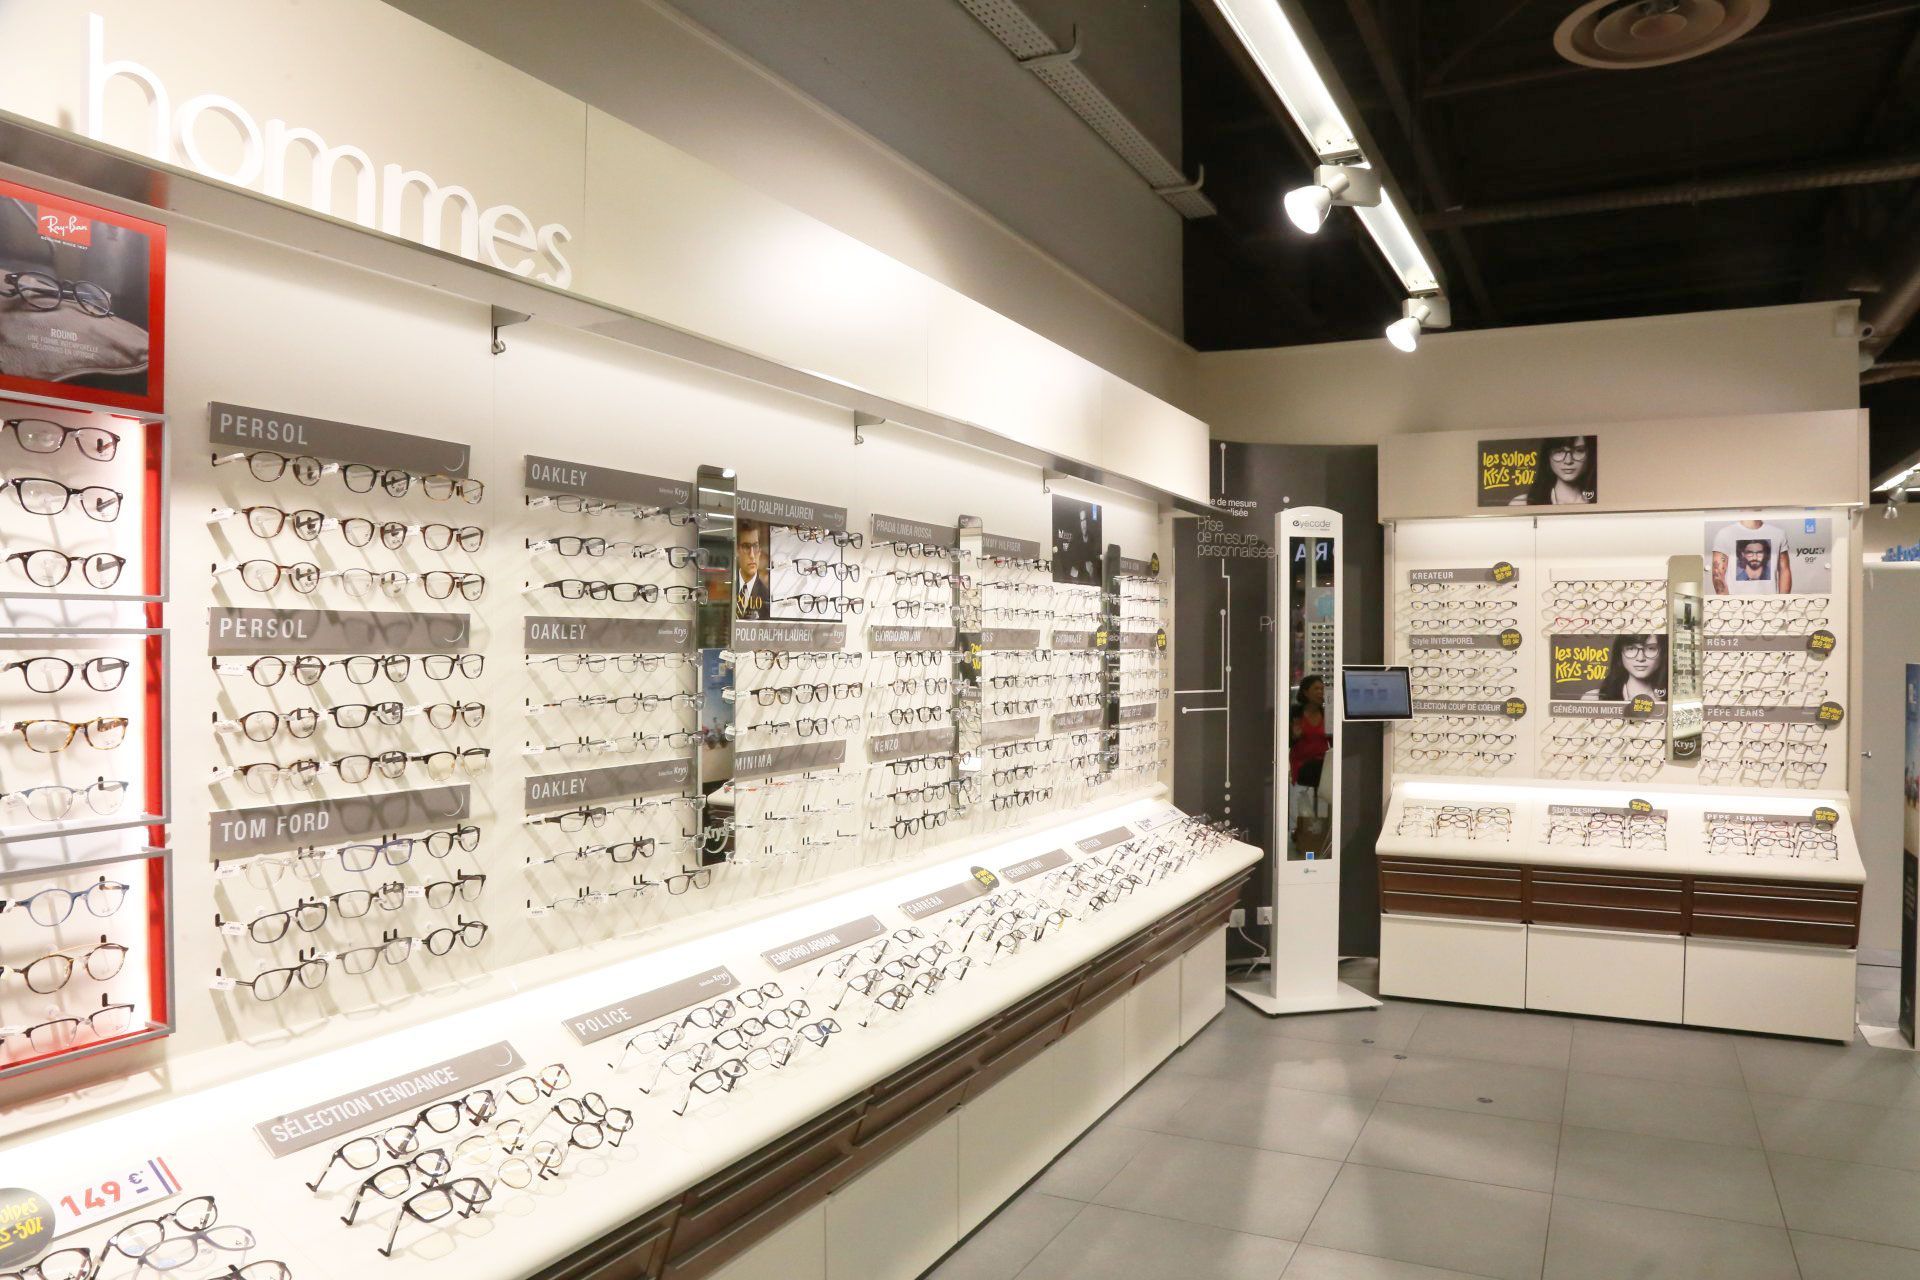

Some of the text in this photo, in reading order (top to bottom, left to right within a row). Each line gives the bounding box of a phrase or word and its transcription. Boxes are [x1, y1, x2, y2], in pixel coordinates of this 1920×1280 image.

[84, 12, 572, 290] hommes
[41, 215, 88, 236] Ray-Ban
[51, 328, 78, 342] ROUND
[220, 412, 309, 446] PERSOL
[531, 462, 588, 488] OAKLEY
[737, 497, 814, 520] POLO RALPH LAUREN
[1217, 497, 1227, 506] de
[1228, 499, 1257, 508] mesure
[875, 520, 896, 533] PRADA
[1197, 528, 1258, 545] de mesure
[1197, 543, 1277, 558] personnalisée
[1412, 571, 1454, 580] KREATEUR
[219, 617, 308, 640] PERSOL
[531, 623, 587, 641] OAKLEY
[735, 627, 814, 642] POLO RALPH LAUREN
[1430, 637, 1475, 645] INTEMPOREL
[1707, 638, 1739, 647] RG512
[1448, 703, 1466, 711] COUP
[1467, 703, 1477, 711] DE
[1552, 704, 1624, 715] GÉNÉRATION MIXTE
[1707, 708, 1765, 718] PEPE JEANS
[874, 738, 899, 753] KENZO
[1674, 740, 1695, 750] Krys
[735, 753, 772, 771] MINIMA
[531, 776, 588, 801] OAKLEY
[1572, 807, 1601, 815] DESIGN
[220, 811, 330, 843] TOM FORD
[906, 895, 944, 915] CARRERA
[769, 932, 841, 966] EMPORIO ARMANI
[575, 1007, 632, 1036] POLICE
[270, 1064, 460, 1143] SÉLECTION TENDANCE
[60, 1180, 121, 1217] 149
